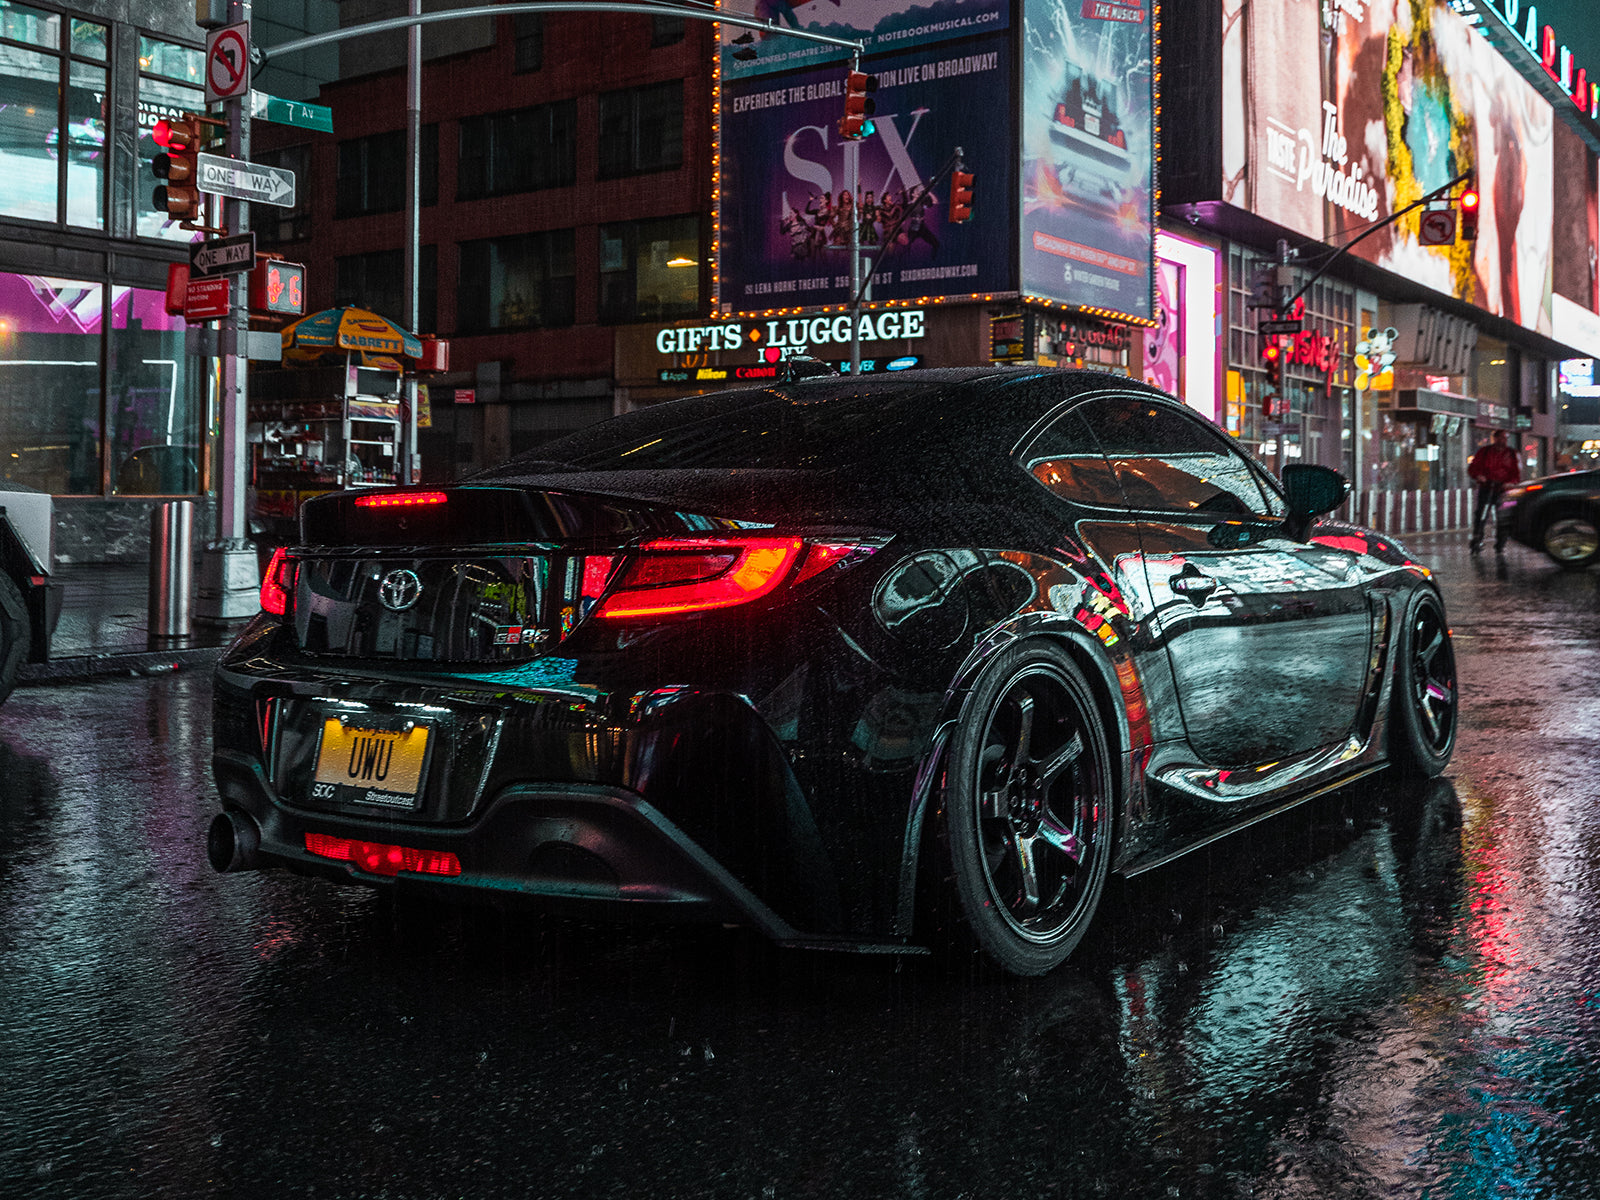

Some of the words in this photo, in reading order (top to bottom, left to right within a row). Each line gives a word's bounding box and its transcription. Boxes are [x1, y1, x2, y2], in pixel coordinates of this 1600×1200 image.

[1094, 3, 1110, 17] THE
[788, 46, 818, 60] THEATRE
[877, 11, 999, 43] NOTEBOOKMUSICAL.COM
[733, 89, 786, 113] EXPERIENCE
[788, 86, 805, 104] THE
[807, 80, 842, 101] GLOBAL
[898, 66, 920, 86] LIVE
[921, 63, 936, 81] ON
[937, 52, 998, 79] BROADWAY!
[286, 103, 294, 121] 7
[1322, 100, 1348, 166] The
[783, 107, 930, 220] SIX
[1297, 128, 1379, 222] Paradise
[207, 167, 235, 185] ONE
[251, 175, 281, 193] WAY
[200, 250, 218, 267] ONE
[225, 244, 247, 261] WAY
[798, 277, 829, 290] THEATRE
[882, 271, 893, 285] ST
[341, 333, 400, 350] SABRETT
[656, 324, 742, 353] GIFTS
[766, 311, 925, 347] LUGGAGE
[696, 368, 727, 380] Nikon
[736, 367, 776, 378] Canon
[348, 737, 394, 781] UWU
[312, 783, 336, 799] SCC
